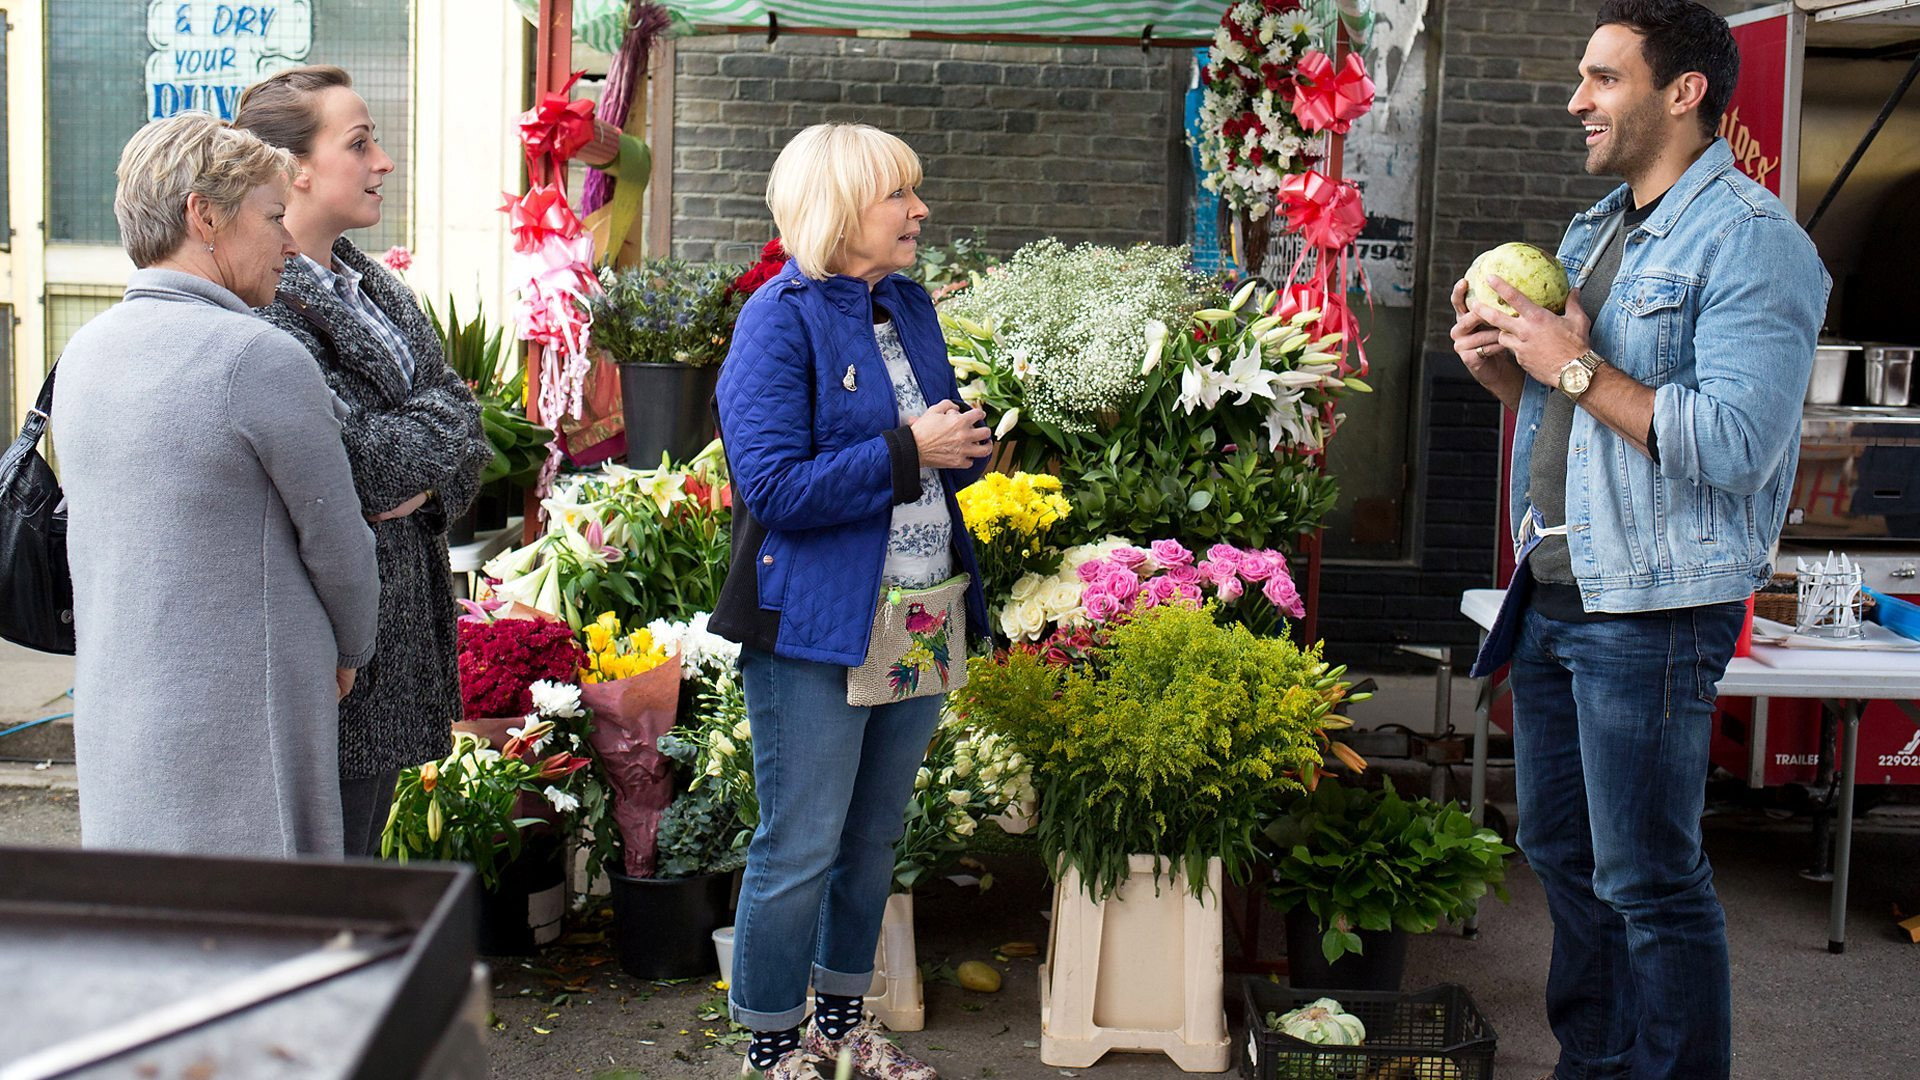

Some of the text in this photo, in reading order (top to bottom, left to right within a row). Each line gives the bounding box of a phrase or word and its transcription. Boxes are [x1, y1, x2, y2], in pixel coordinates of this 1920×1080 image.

[175, 4, 275, 36] & DRY
[175, 47, 237, 74] YOUR
[153, 83, 246, 120] DUV
[1878, 754, 1920, 767] 22902
